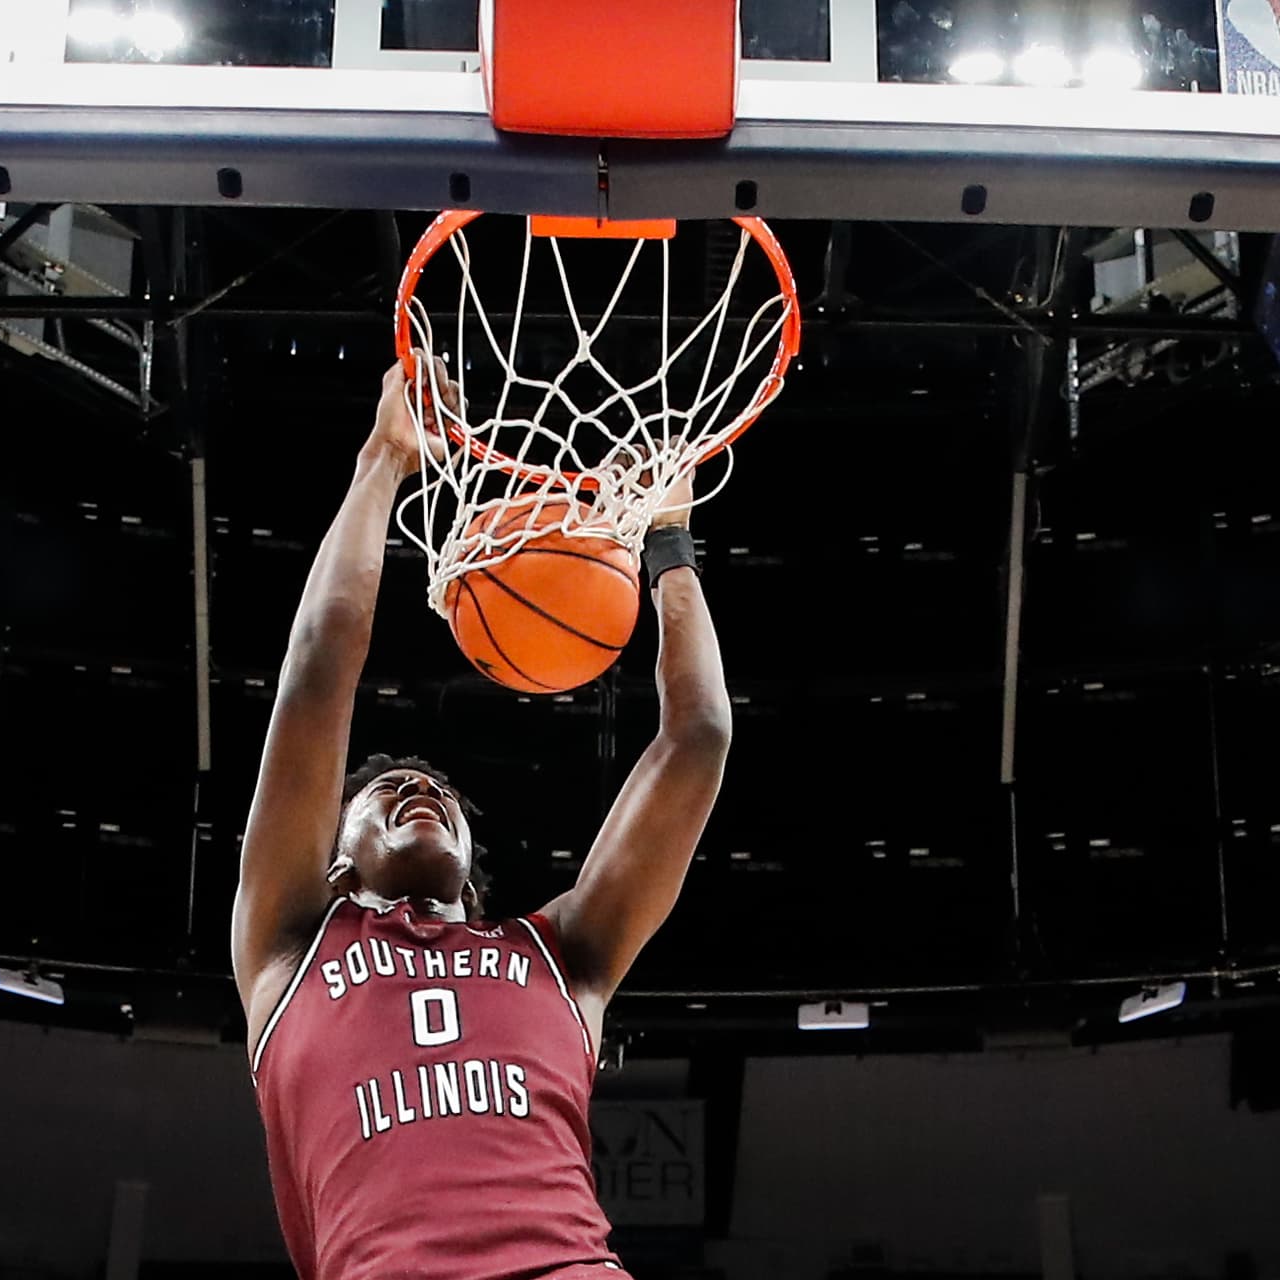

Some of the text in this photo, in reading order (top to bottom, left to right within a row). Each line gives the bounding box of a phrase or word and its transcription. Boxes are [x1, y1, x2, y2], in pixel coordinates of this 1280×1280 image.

[320, 936, 531, 1001] SOUTHERN
[408, 986, 461, 1047] 0
[354, 1059, 531, 1140] ILLINOIS
